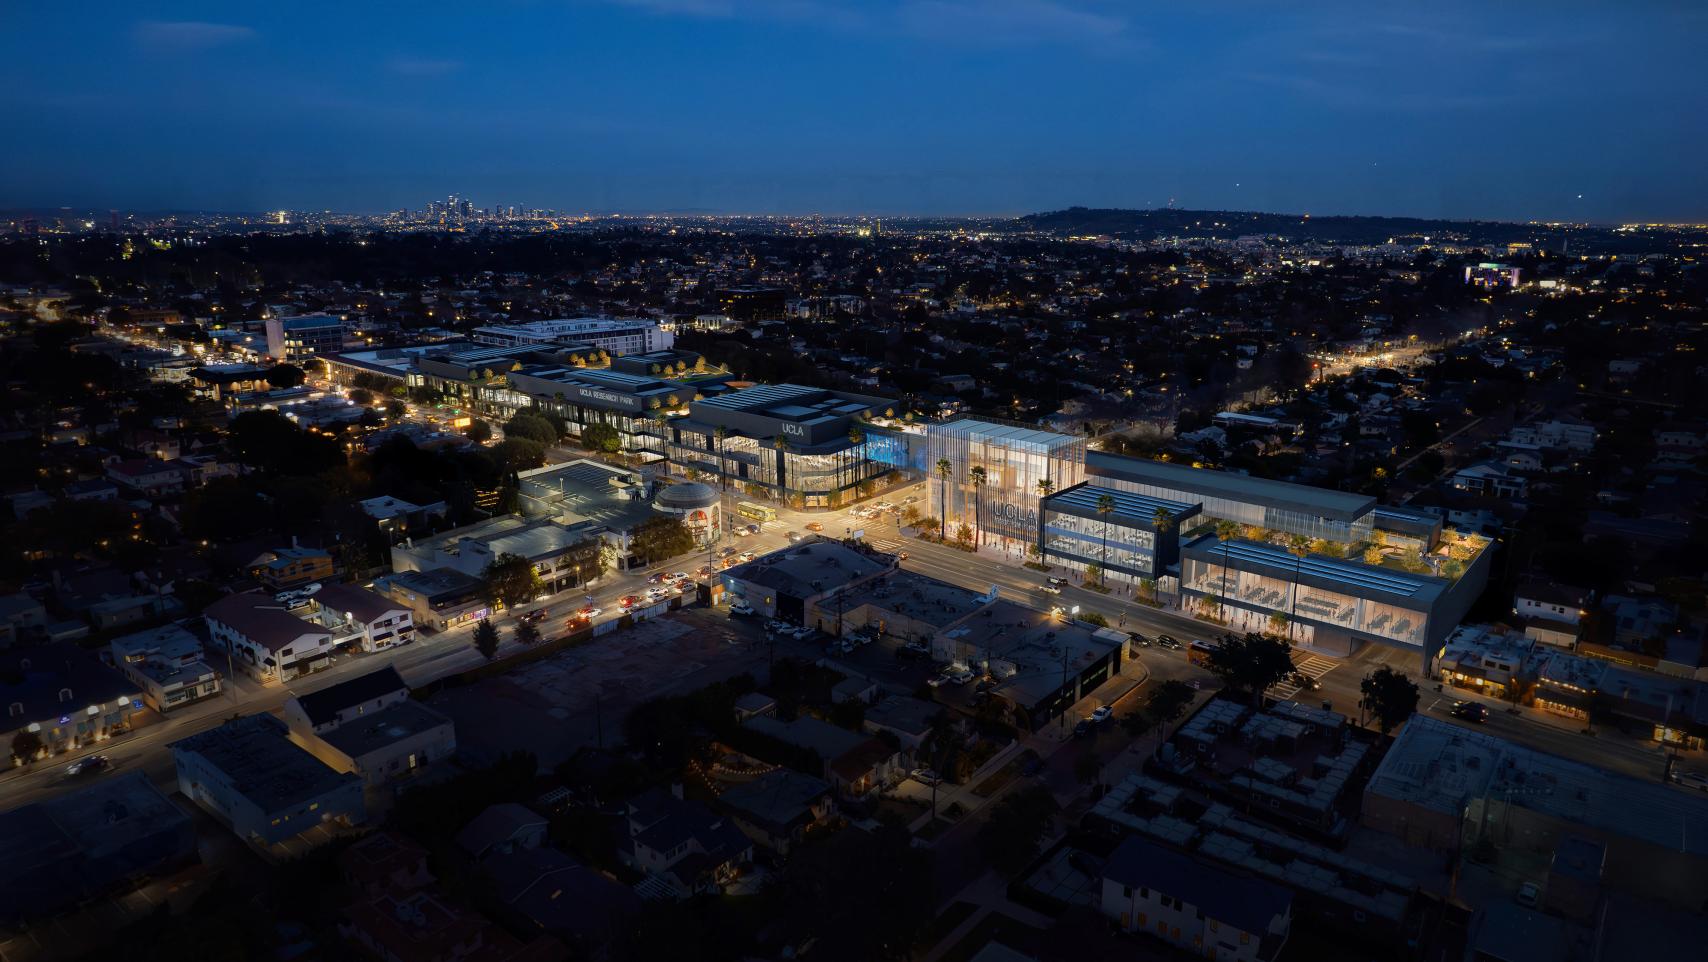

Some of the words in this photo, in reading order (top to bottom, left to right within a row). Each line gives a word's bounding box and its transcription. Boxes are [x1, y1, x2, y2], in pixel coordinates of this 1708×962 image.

[580, 389, 592, 398] UCLA
[593, 391, 619, 402] RESEARCH
[620, 396, 633, 405] PARK
[782, 423, 803, 436] UCLA
[993, 501, 1037, 525] UCLA
